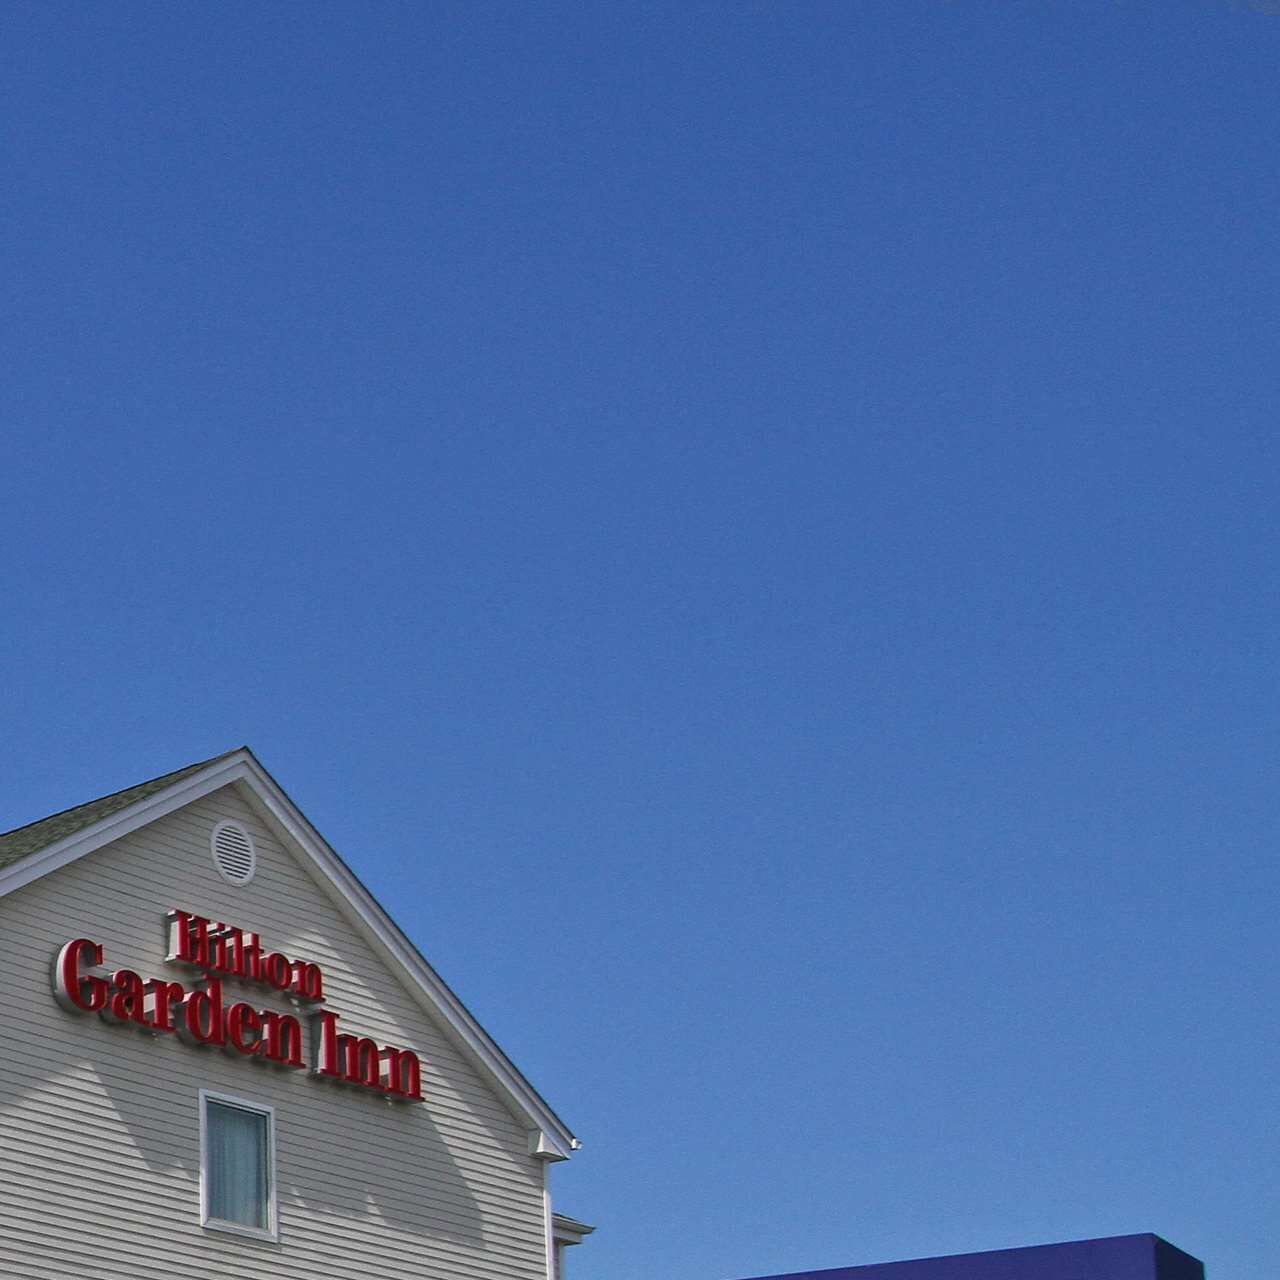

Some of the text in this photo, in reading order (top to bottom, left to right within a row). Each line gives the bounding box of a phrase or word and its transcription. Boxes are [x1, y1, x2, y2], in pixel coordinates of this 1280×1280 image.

[57, 937, 426, 1102] Garden Inn
[166, 908, 326, 1002] Hilton
